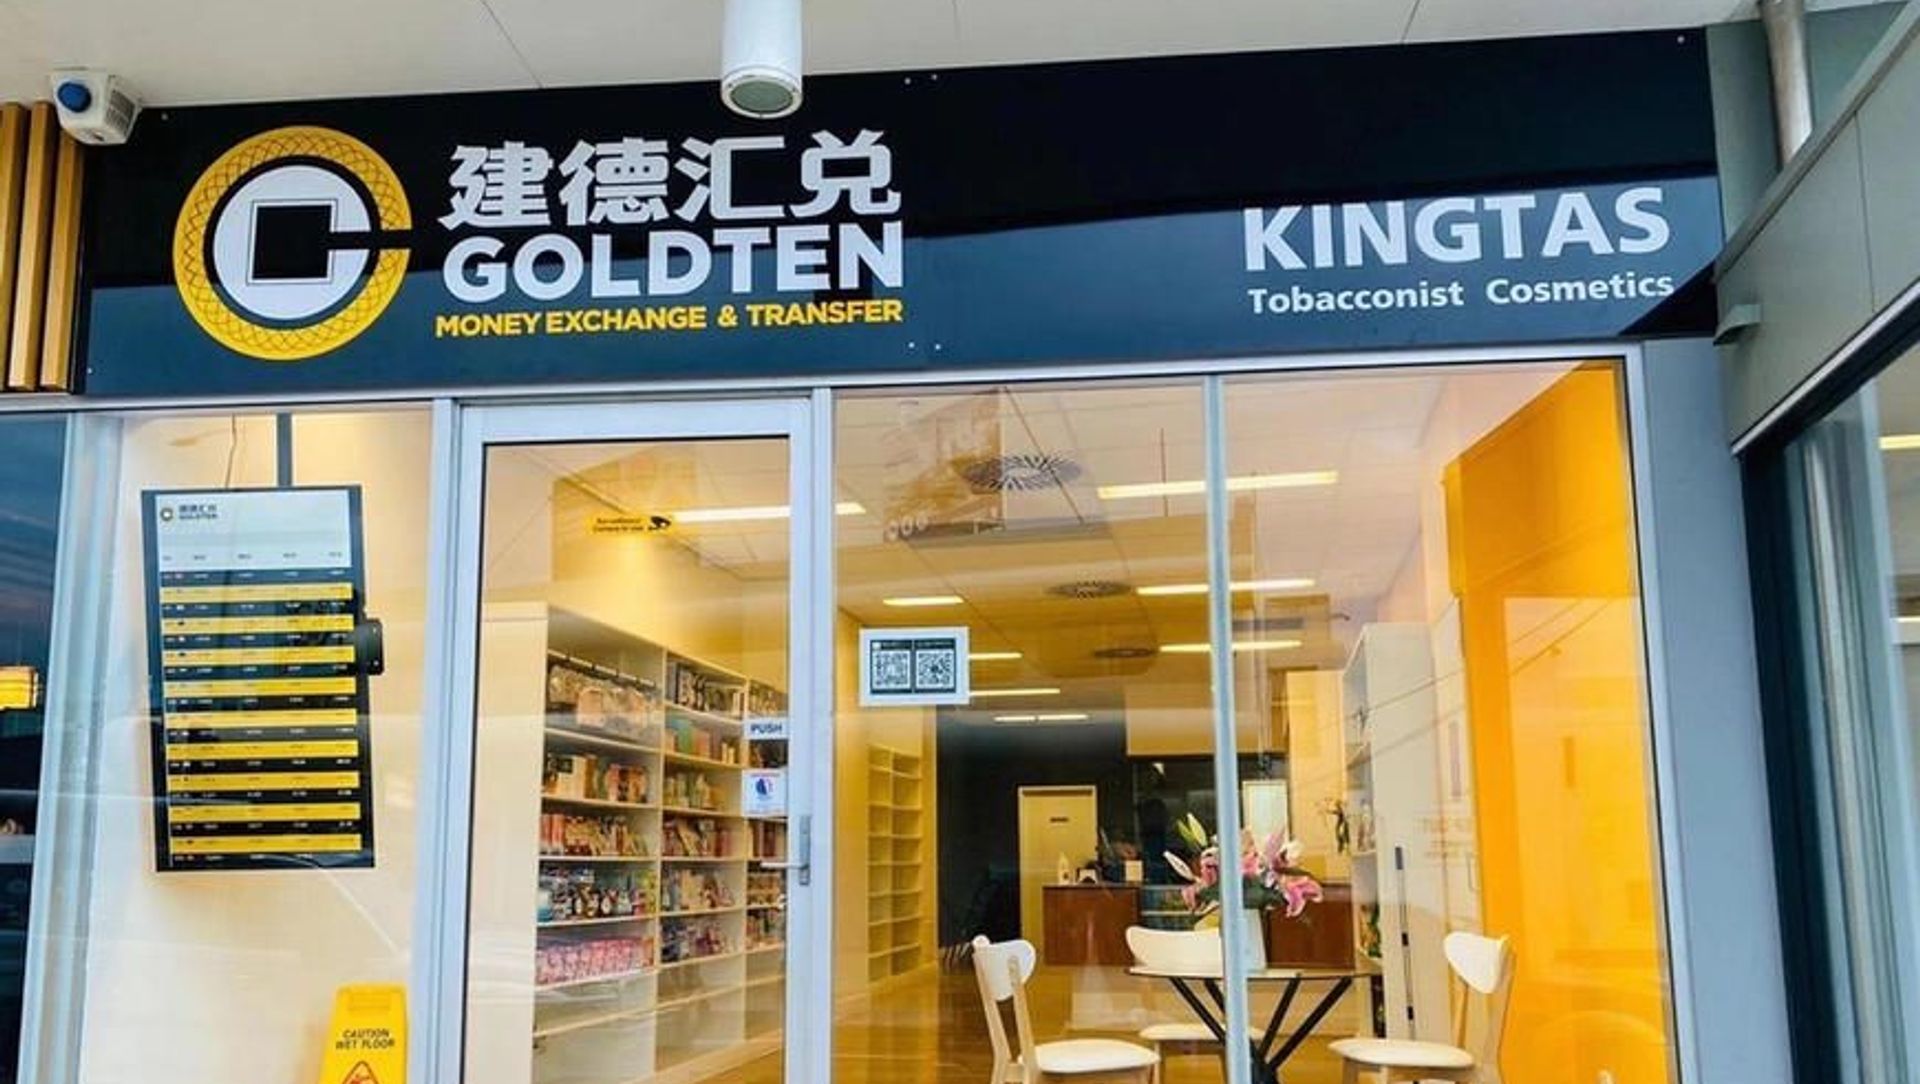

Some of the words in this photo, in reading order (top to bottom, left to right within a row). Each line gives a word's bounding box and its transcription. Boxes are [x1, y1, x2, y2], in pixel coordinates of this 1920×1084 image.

[437, 128, 901, 230] 建德汇兑
[1243, 186, 1671, 272] KINGTAS
[442, 220, 904, 303] GOLDTEN
[1248, 280, 1464, 314] Tobacconist
[1486, 271, 1674, 305] Cosmetics
[435, 311, 539, 338] MONEY
[545, 306, 707, 334] EXCHANGE
[717, 304, 738, 328] &
[746, 299, 904, 327] TRANSFER
[750, 722, 782, 734] PUSH
[335, 1040, 357, 1050] WET
[361, 1038, 395, 1049] FLOOR
[342, 1028, 390, 1039] CAUTION
